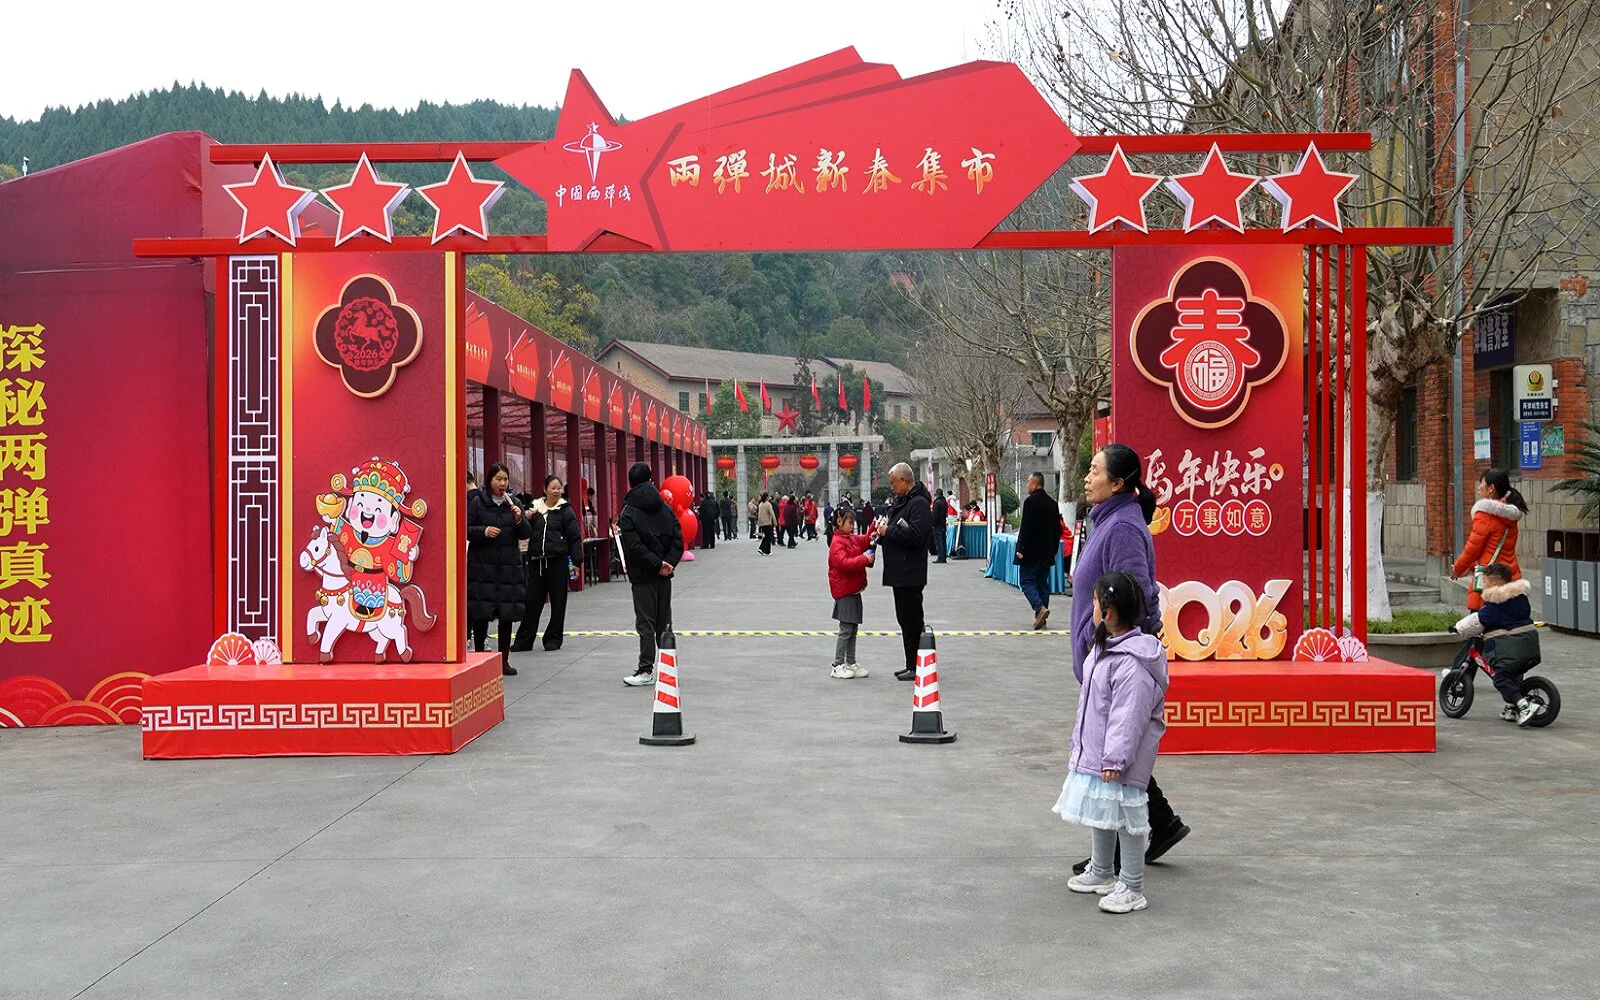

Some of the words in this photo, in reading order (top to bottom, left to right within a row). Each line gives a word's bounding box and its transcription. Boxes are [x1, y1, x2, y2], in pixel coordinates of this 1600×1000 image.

[354, 350, 378, 359] 2026
[1160, 288, 1261, 410] 春
[1191, 349, 1229, 392] 福
[0, 323, 53, 644] 探秘两弹真迹
[1144, 447, 1272, 505] 马年快乐
[1178, 507, 1265, 529] 万事如意
